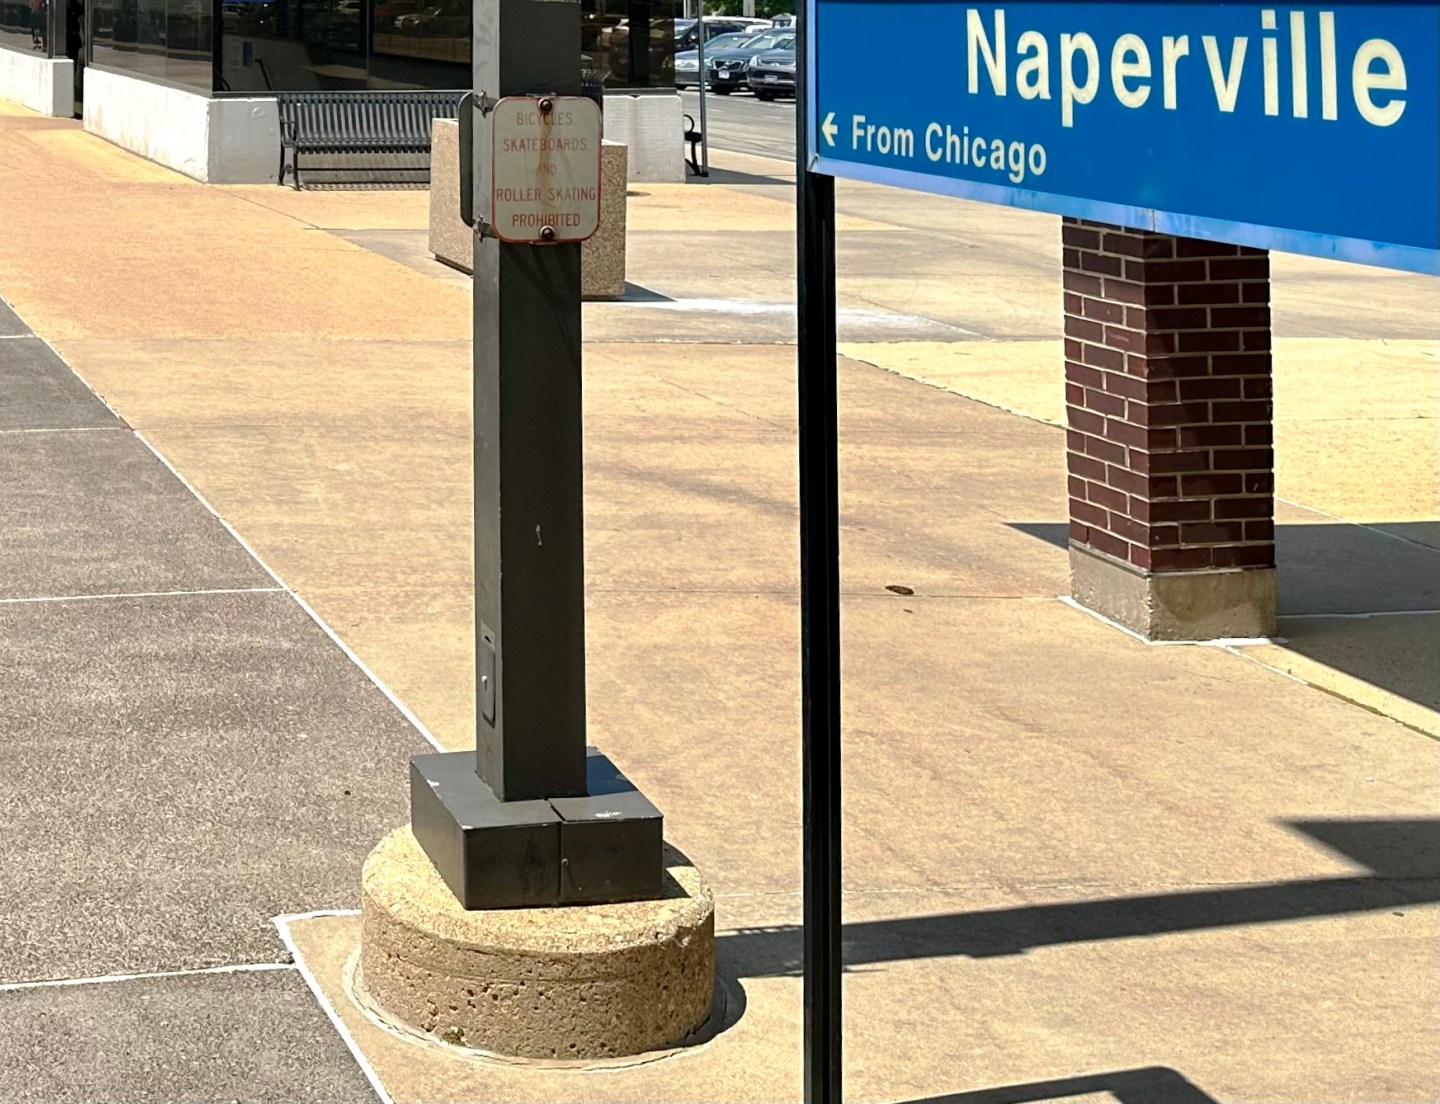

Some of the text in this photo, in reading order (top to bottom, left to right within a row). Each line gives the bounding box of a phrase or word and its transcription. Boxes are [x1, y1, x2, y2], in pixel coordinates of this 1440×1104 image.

[966, 7, 1408, 128] Naperville
[852, 114, 1047, 183] From Chicago
[535, 163, 558, 176] AND
[496, 187, 597, 202] ROLLER SKATING
[512, 213, 581, 228] PROHIBITED
